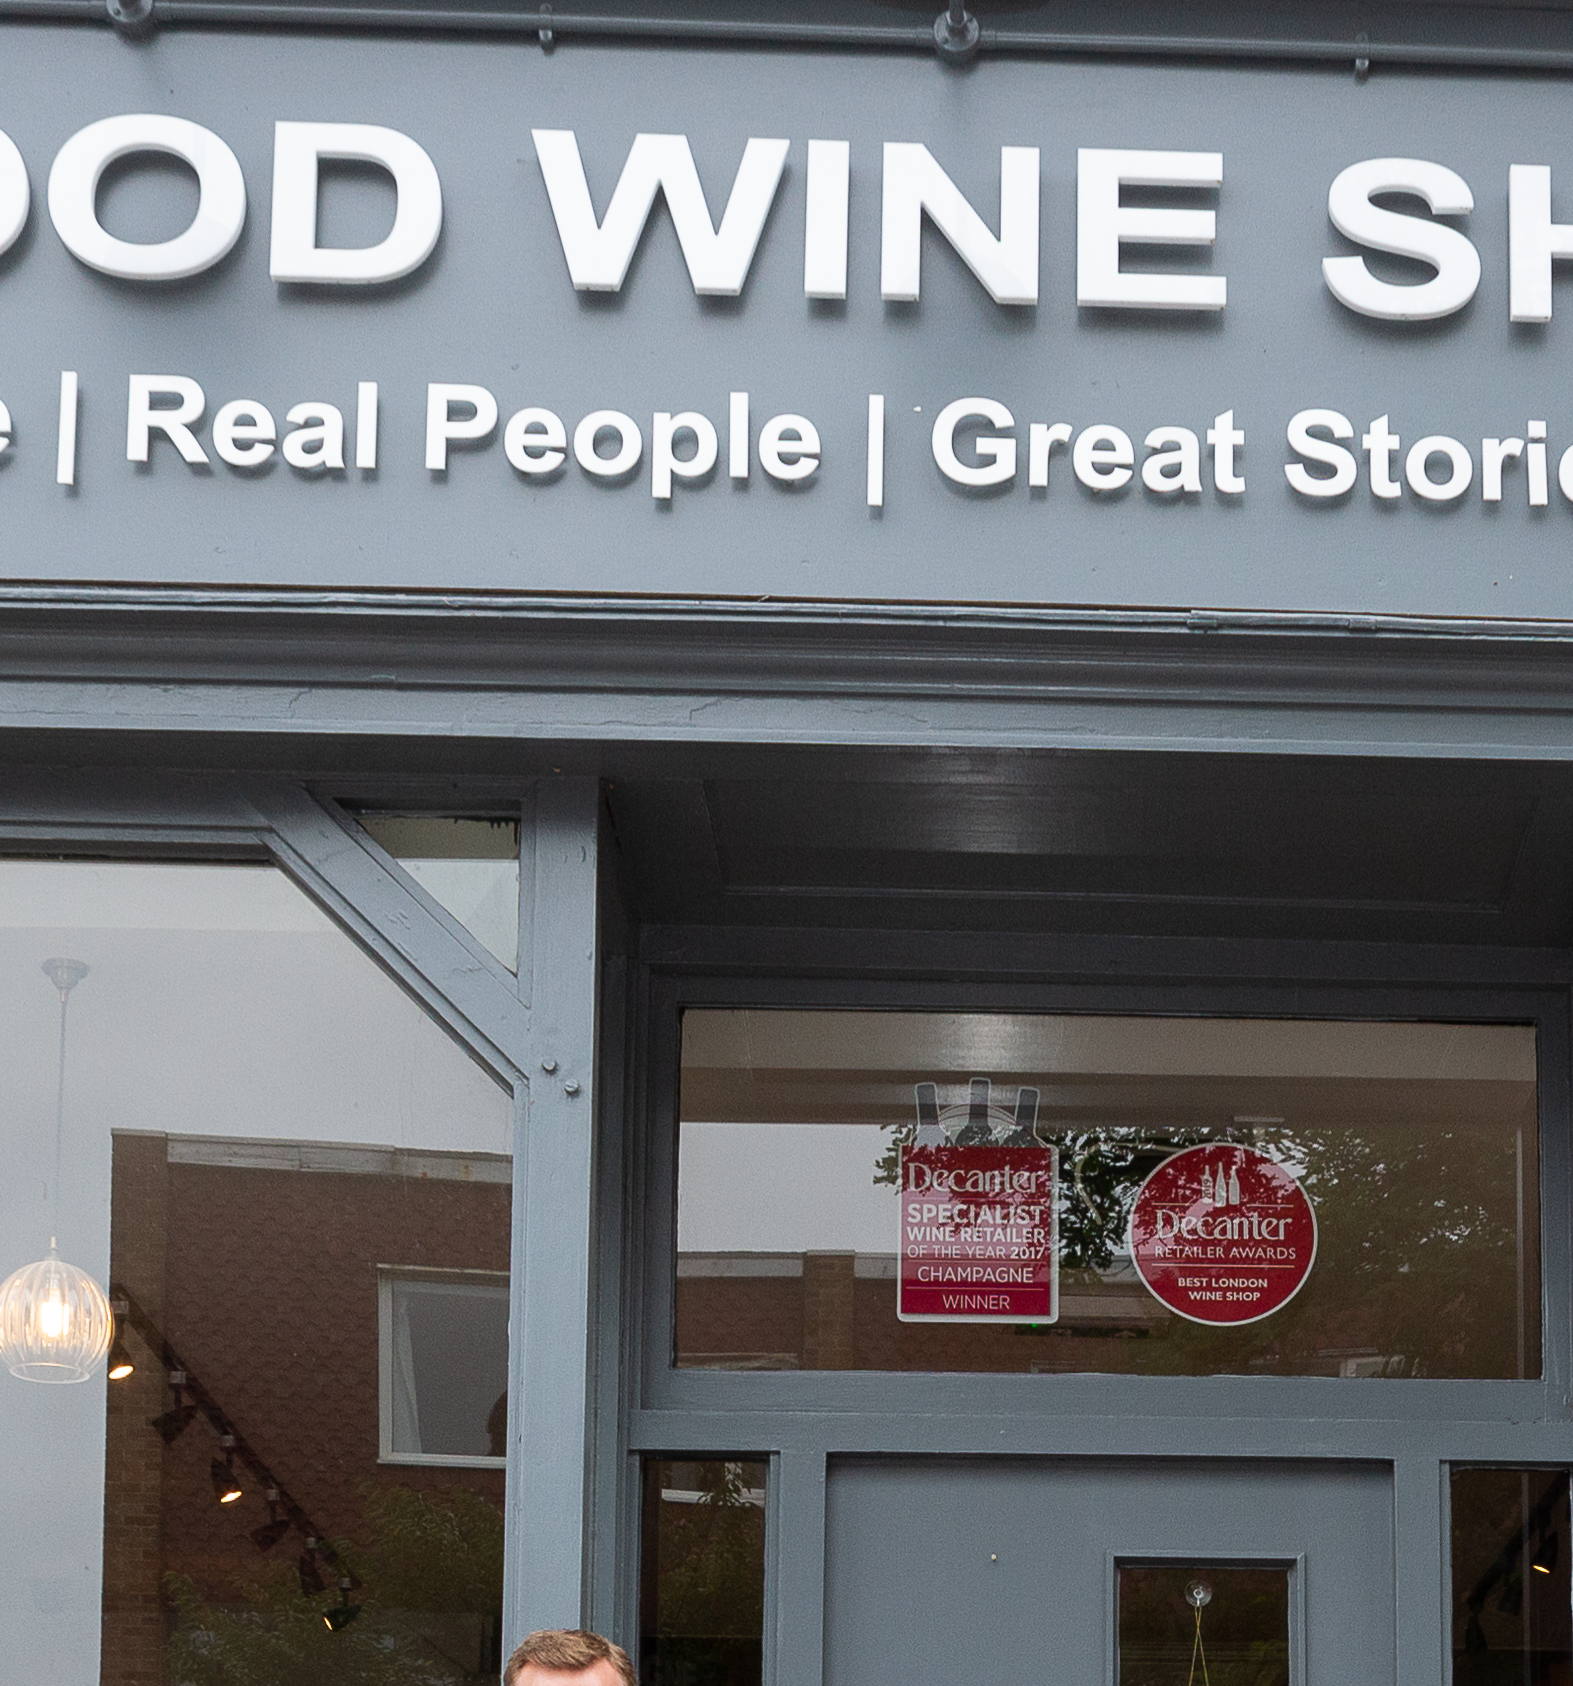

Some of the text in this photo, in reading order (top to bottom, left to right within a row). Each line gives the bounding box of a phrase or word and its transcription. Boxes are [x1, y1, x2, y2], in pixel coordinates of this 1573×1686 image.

[531, 126, 1228, 311] WINE
[126, 374, 377, 472] Real
[425, 383, 822, 500] People
[931, 396, 1246, 498] Great
[907, 1162, 1042, 1193] Decanter
[907, 1204, 1044, 1225] SPECIALIST
[1155, 1210, 1293, 1240] Decanter
[907, 1227, 1044, 1243] WINE RETAILER
[907, 1245, 1044, 1260] OF THE YEAR 2017
[1155, 1246, 1296, 1260] RETAILER AWARDS
[917, 1266, 1034, 1283] CHAMPAGNE
[1178, 1277, 1268, 1289] BEST LONDON
[942, 1295, 1010, 1310] WINNER
[1189, 1291, 1261, 1302] WINE SHOP
